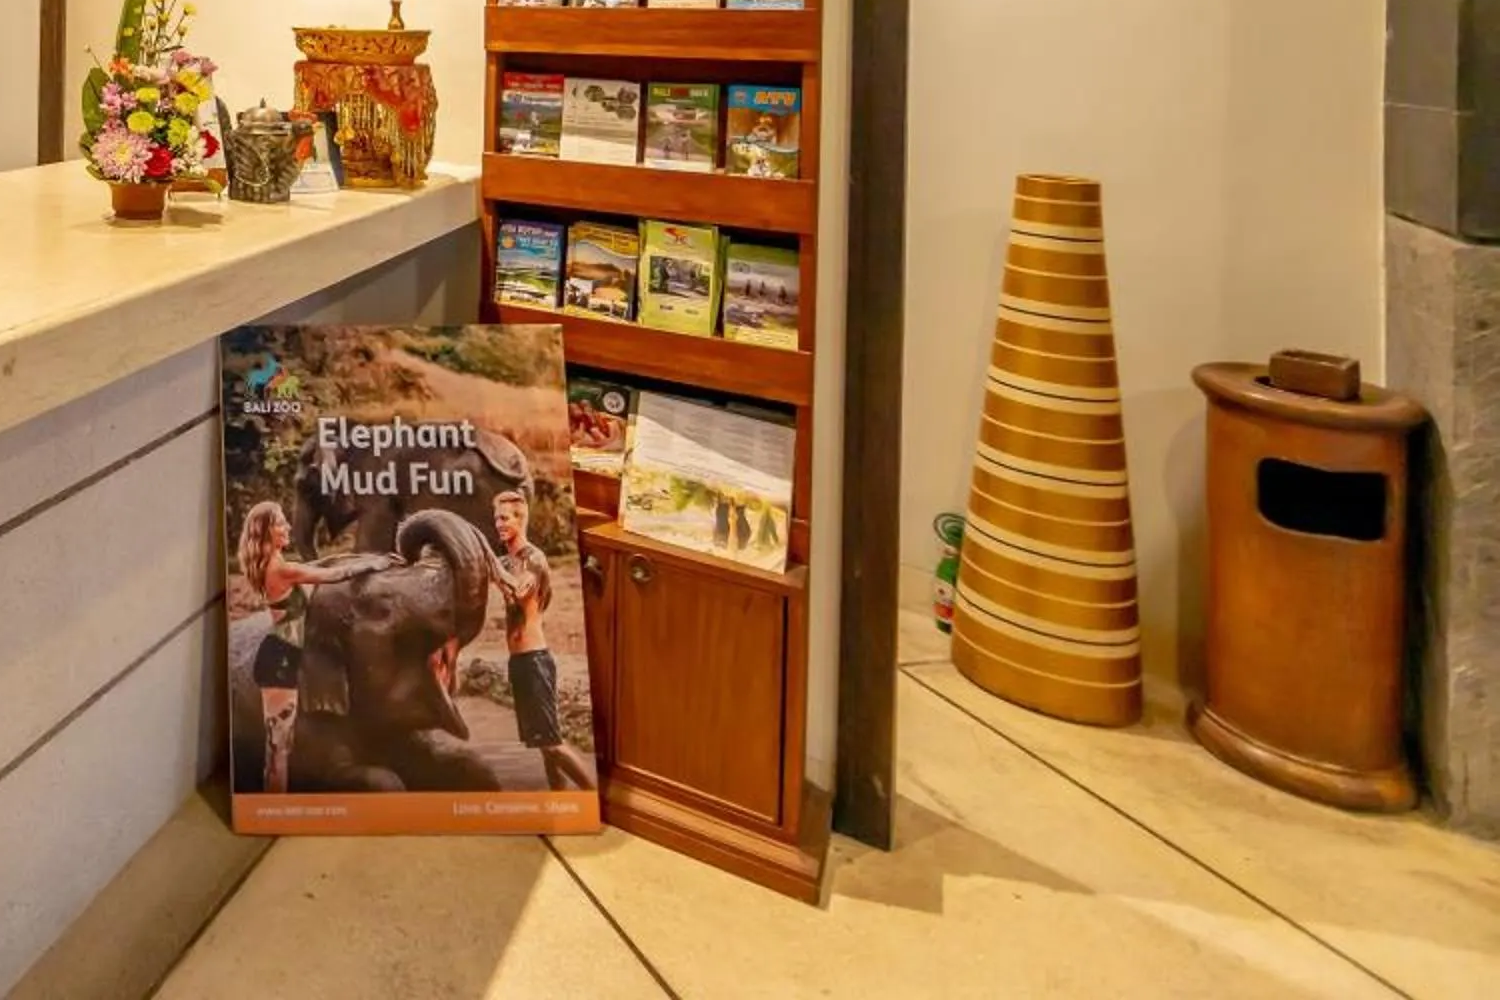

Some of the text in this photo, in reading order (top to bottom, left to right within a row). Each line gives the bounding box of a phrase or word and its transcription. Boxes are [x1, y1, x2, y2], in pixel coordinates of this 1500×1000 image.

[243, 400, 301, 413] BALI ZOO
[318, 415, 477, 457] Elephant
[320, 460, 474, 496] Mud Fun
